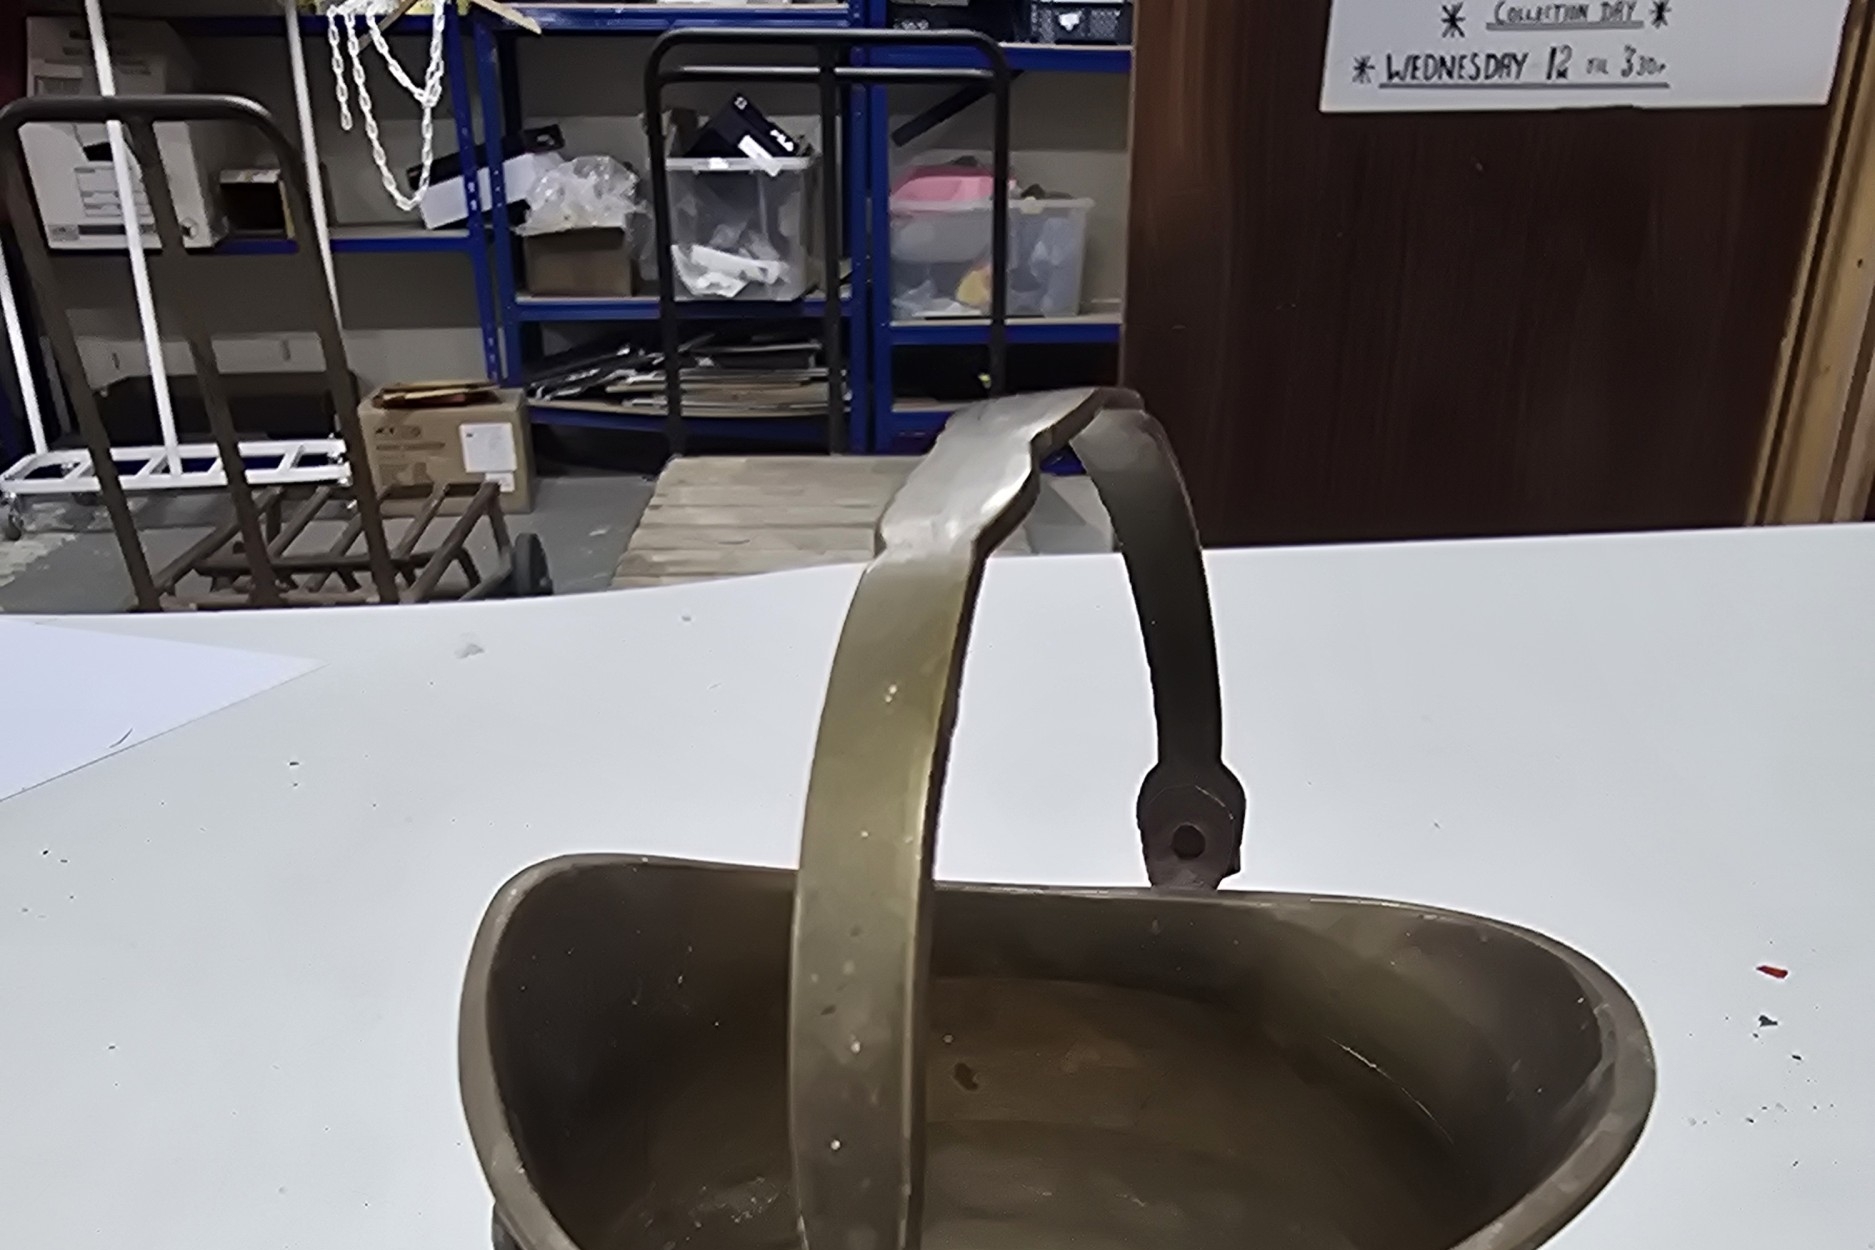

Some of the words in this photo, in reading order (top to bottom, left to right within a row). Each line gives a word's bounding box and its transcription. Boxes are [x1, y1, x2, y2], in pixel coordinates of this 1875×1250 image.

[1601, 0, 1637, 22] DAY
[1386, 52, 1529, 81] WEDNESDAY
[1546, 44, 1573, 81] 12
